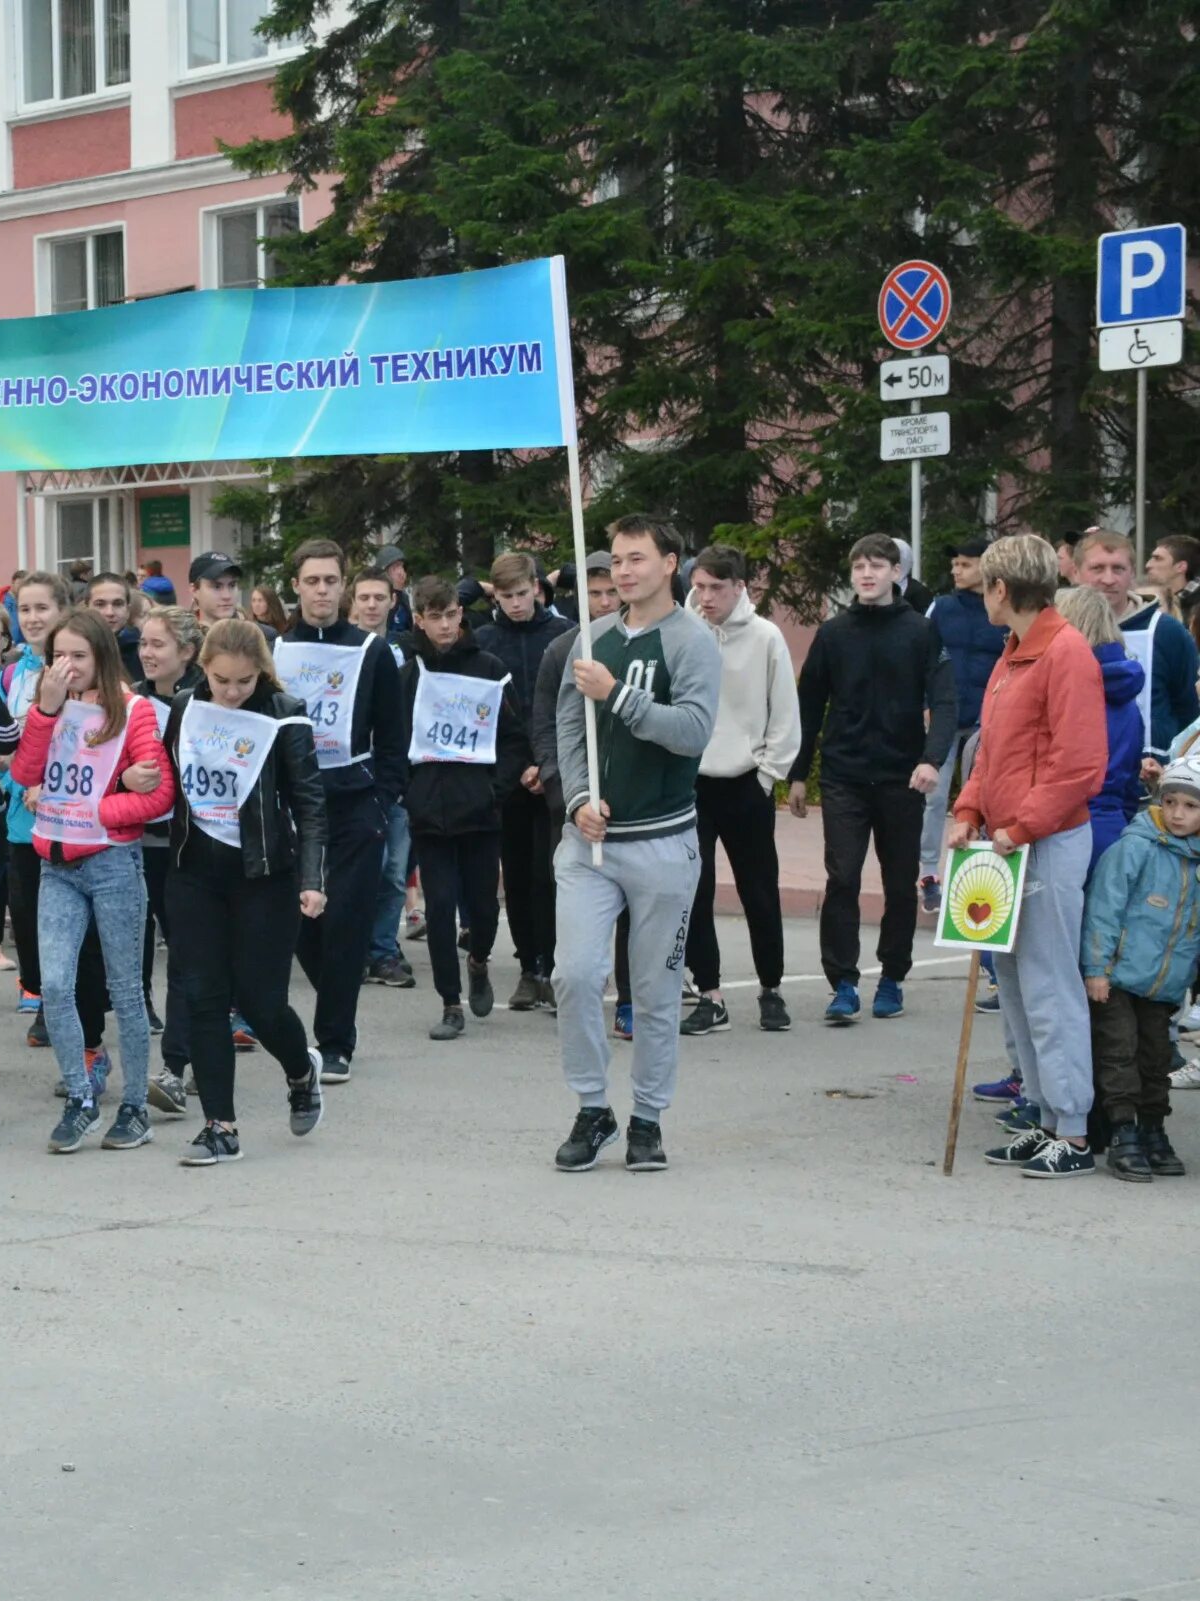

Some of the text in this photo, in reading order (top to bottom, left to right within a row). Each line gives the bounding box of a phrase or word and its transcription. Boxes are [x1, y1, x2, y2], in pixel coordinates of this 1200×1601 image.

[1120, 240, 1166, 315] P
[370, 342, 543, 385] ТЕХНИКУМ
[890, 425, 938, 437] ТРАНСПОРТА
[900, 416, 928, 427] КРОМЕ
[426, 721, 480, 753] 4941
[40, 761, 94, 797] 938
[181, 763, 239, 798] 4937
